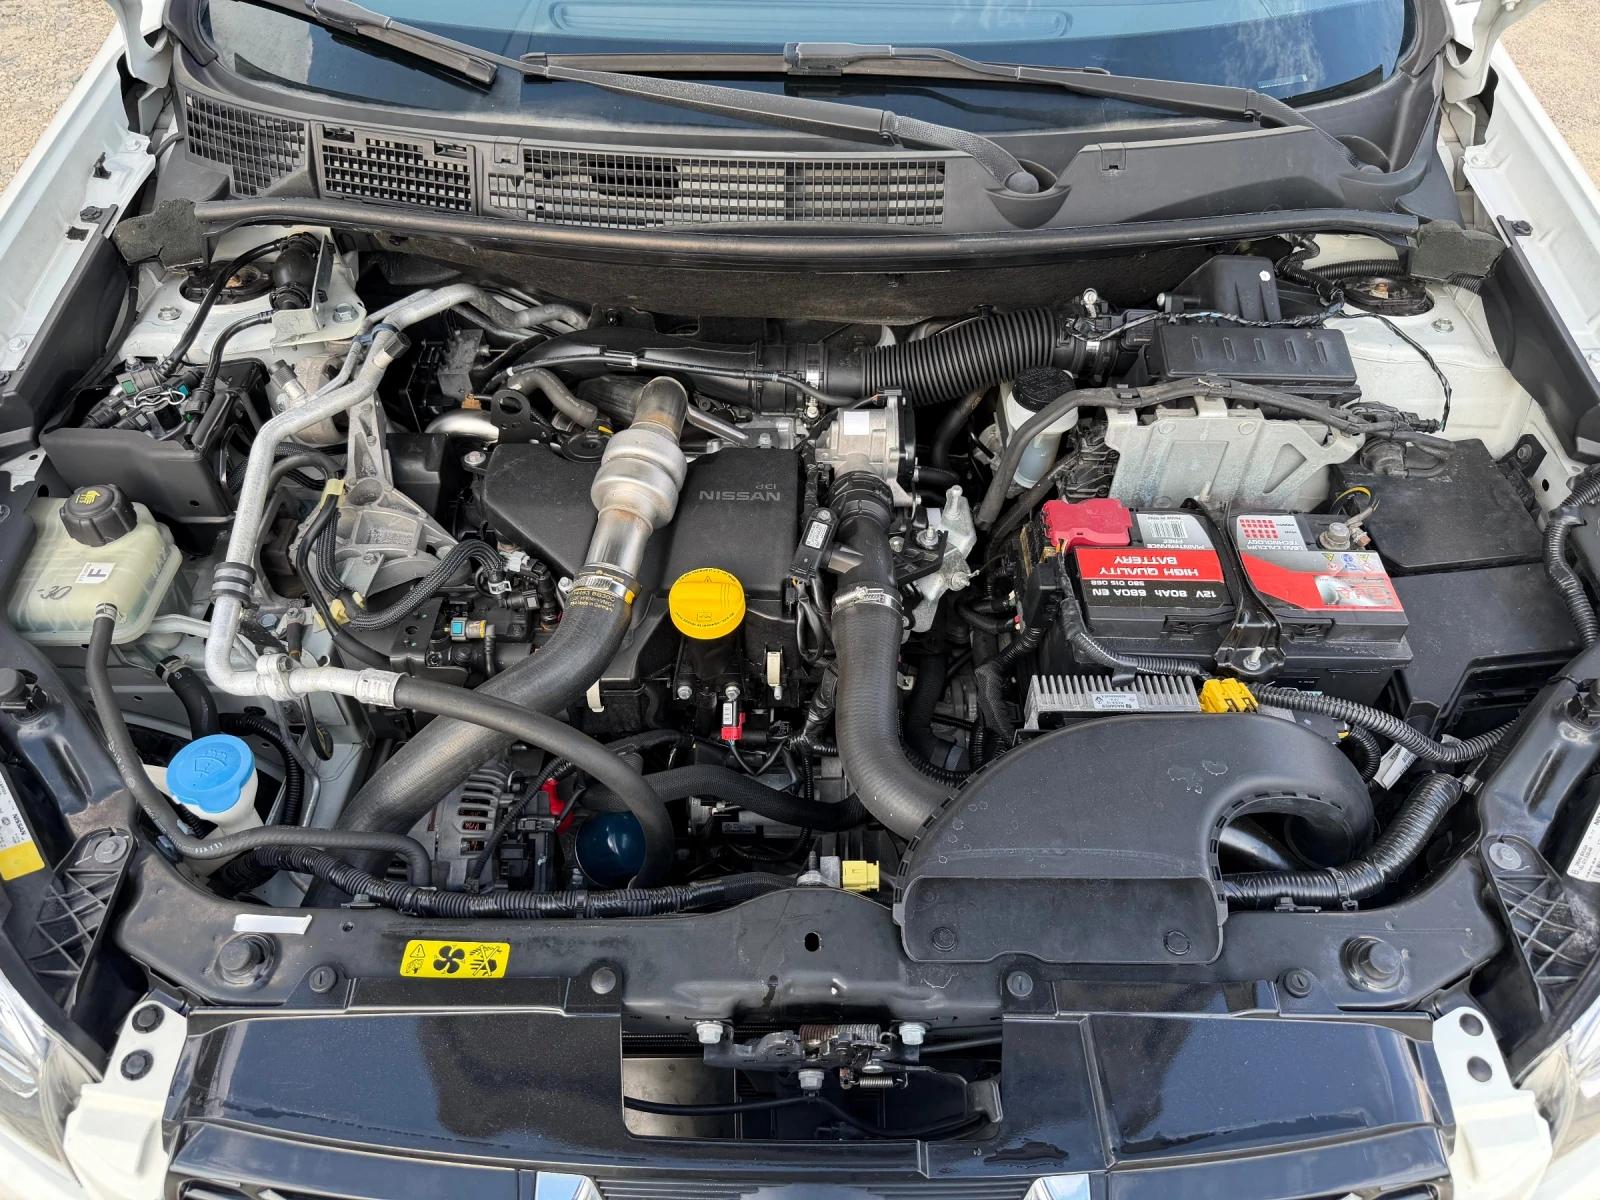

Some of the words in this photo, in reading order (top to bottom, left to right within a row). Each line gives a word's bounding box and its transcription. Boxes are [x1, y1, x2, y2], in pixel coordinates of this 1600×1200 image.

[698, 490, 781, 502] NISSAN
[1113, 555, 1178, 565] BATTERY
[86, 568, 107, 578] F
[1099, 567, 1159, 576] QUALITY
[1163, 567, 1199, 577] HIGH
[1092, 588, 1109, 596] EN
[1112, 588, 1147, 597] 680A
[1154, 589, 1188, 597] 80Ah
[1195, 590, 1217, 598] 12V
[12, 813, 27, 836] NISSAN
